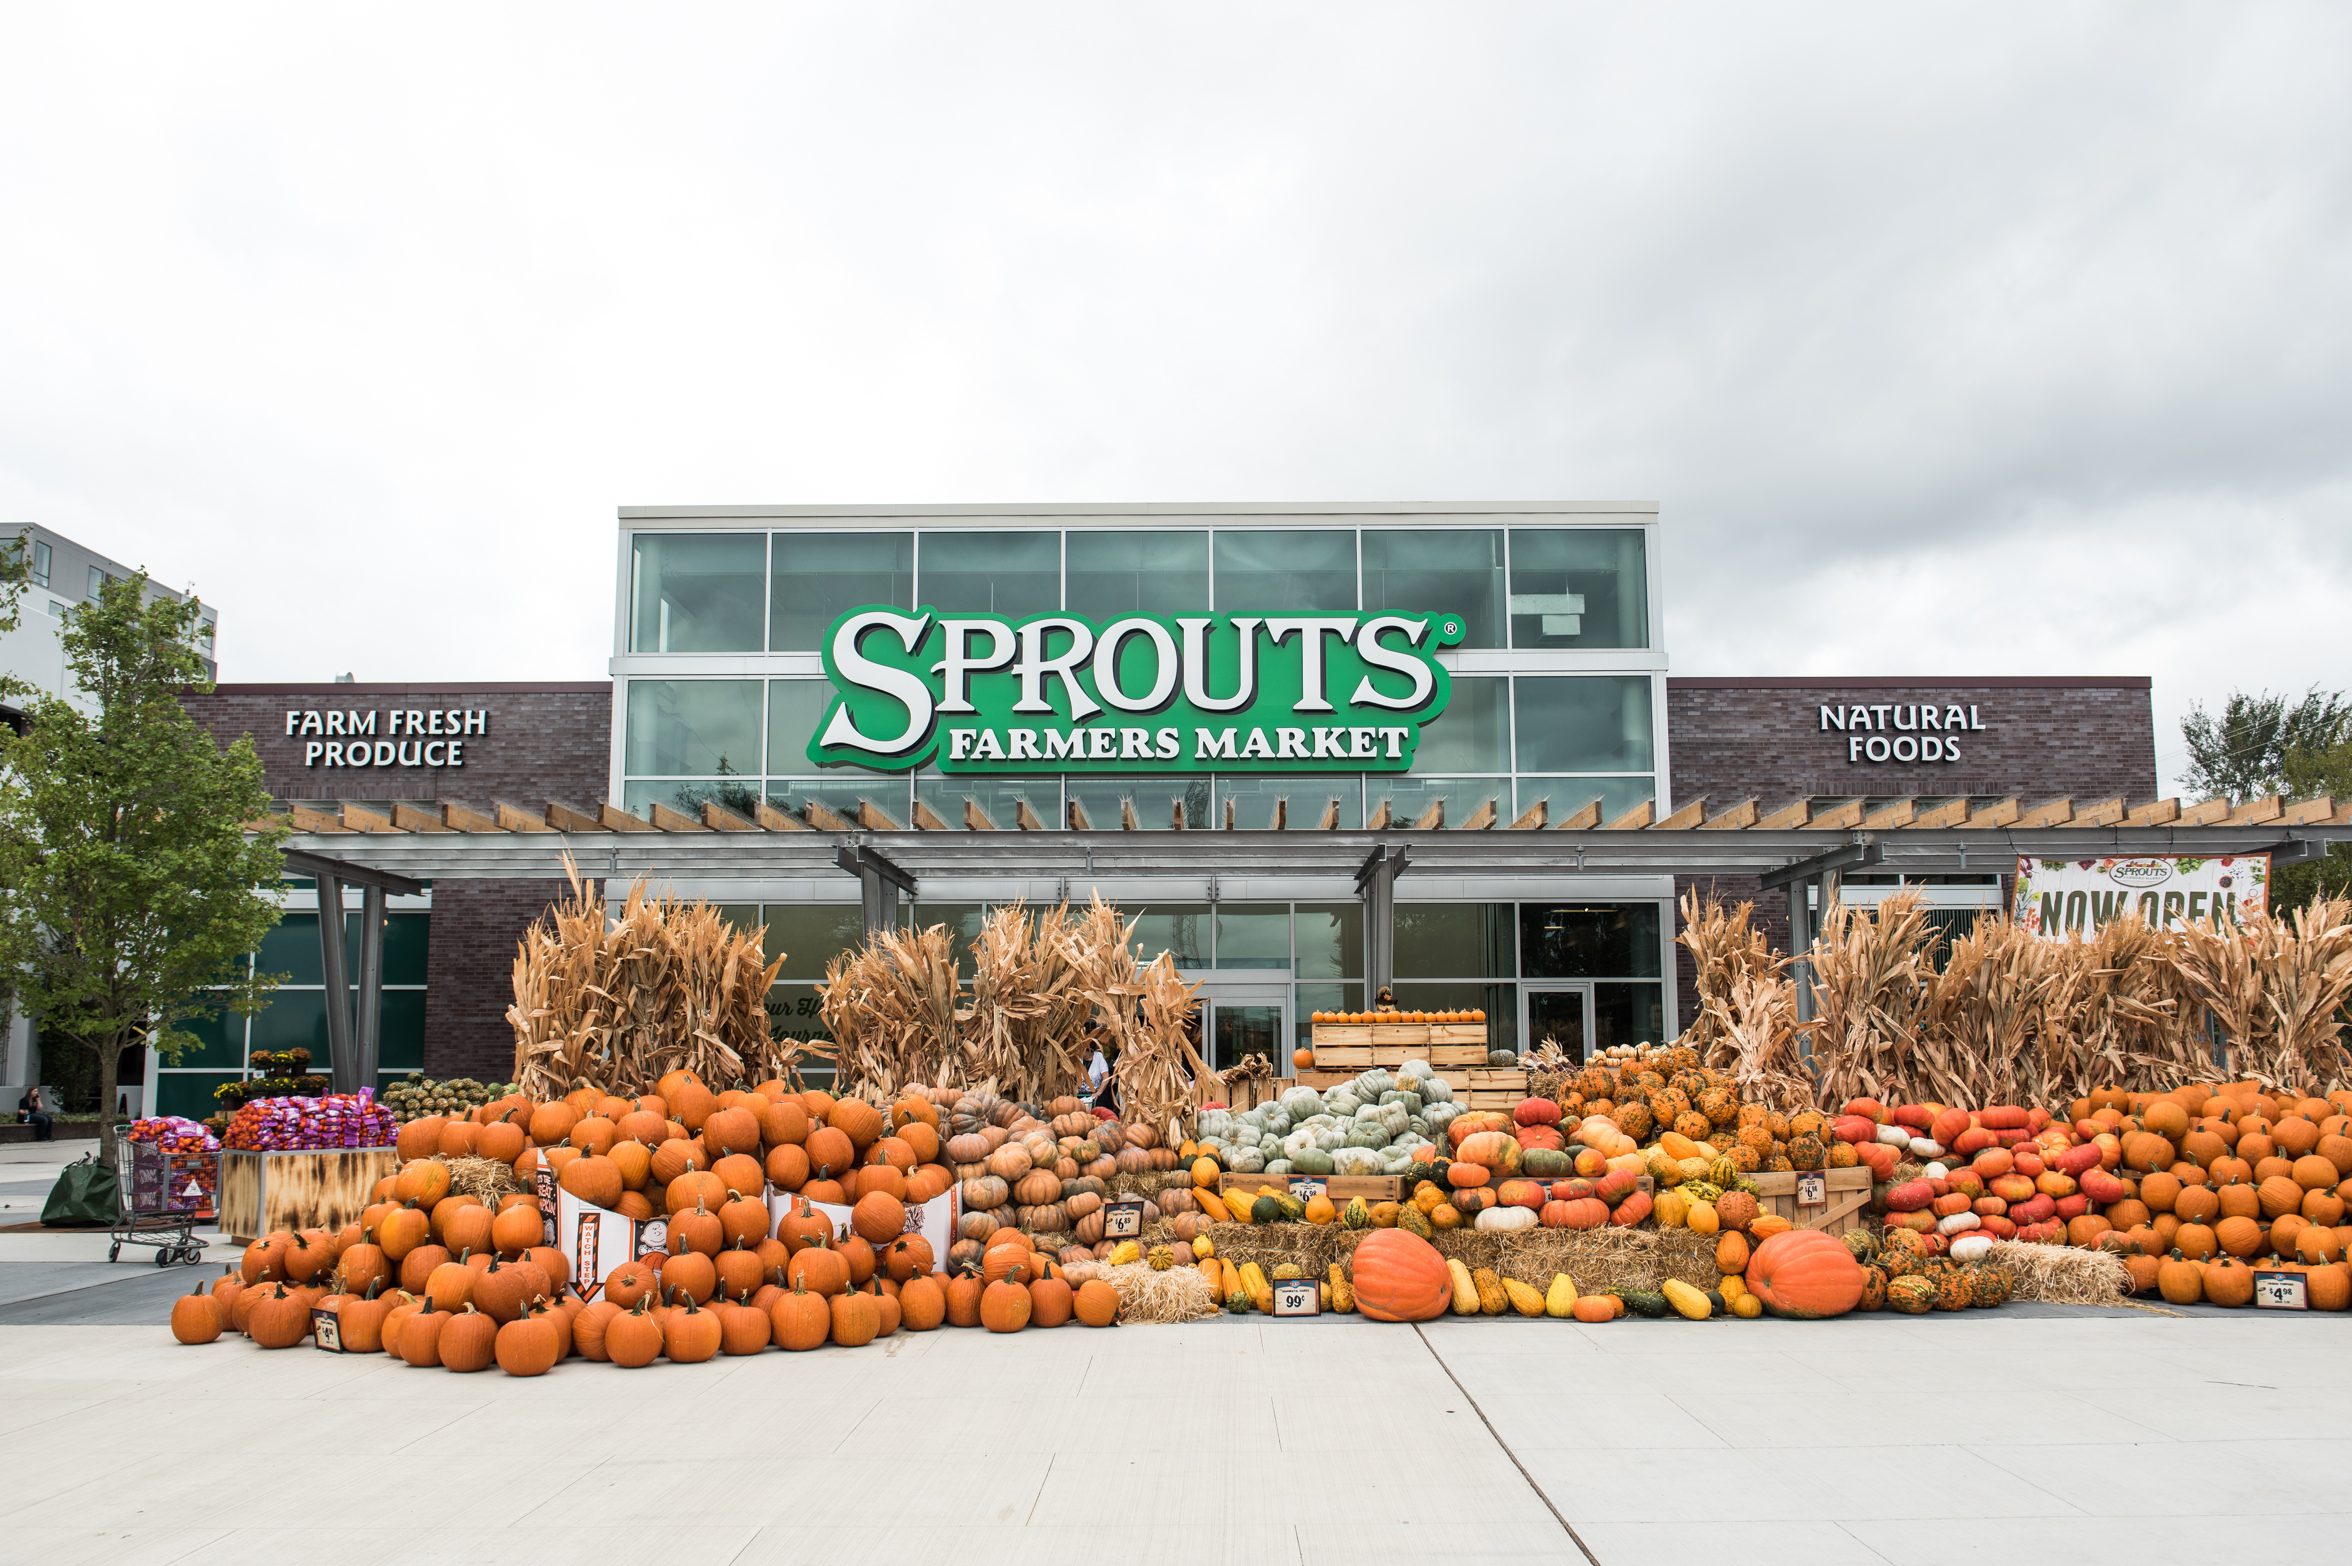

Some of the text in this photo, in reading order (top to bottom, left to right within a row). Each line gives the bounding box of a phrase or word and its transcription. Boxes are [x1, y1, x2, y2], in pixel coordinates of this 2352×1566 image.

[820, 610, 1440, 752] SPROUTS
[285, 709, 487, 736] FARM FRESH
[1819, 704, 1987, 731] NATURAL
[305, 741, 463, 767] PRODUCE
[948, 725, 1410, 761] FARMERS MARKET
[1848, 735, 1962, 763] FOODS
[2114, 867, 2168, 879] SPROUTS
[2038, 890, 2237, 938] NOW OPEN
[768, 1025, 836, 1044] Journe
[537, 1184, 553, 1199] REAT
[583, 1225, 594, 1285] WATCH STEP
